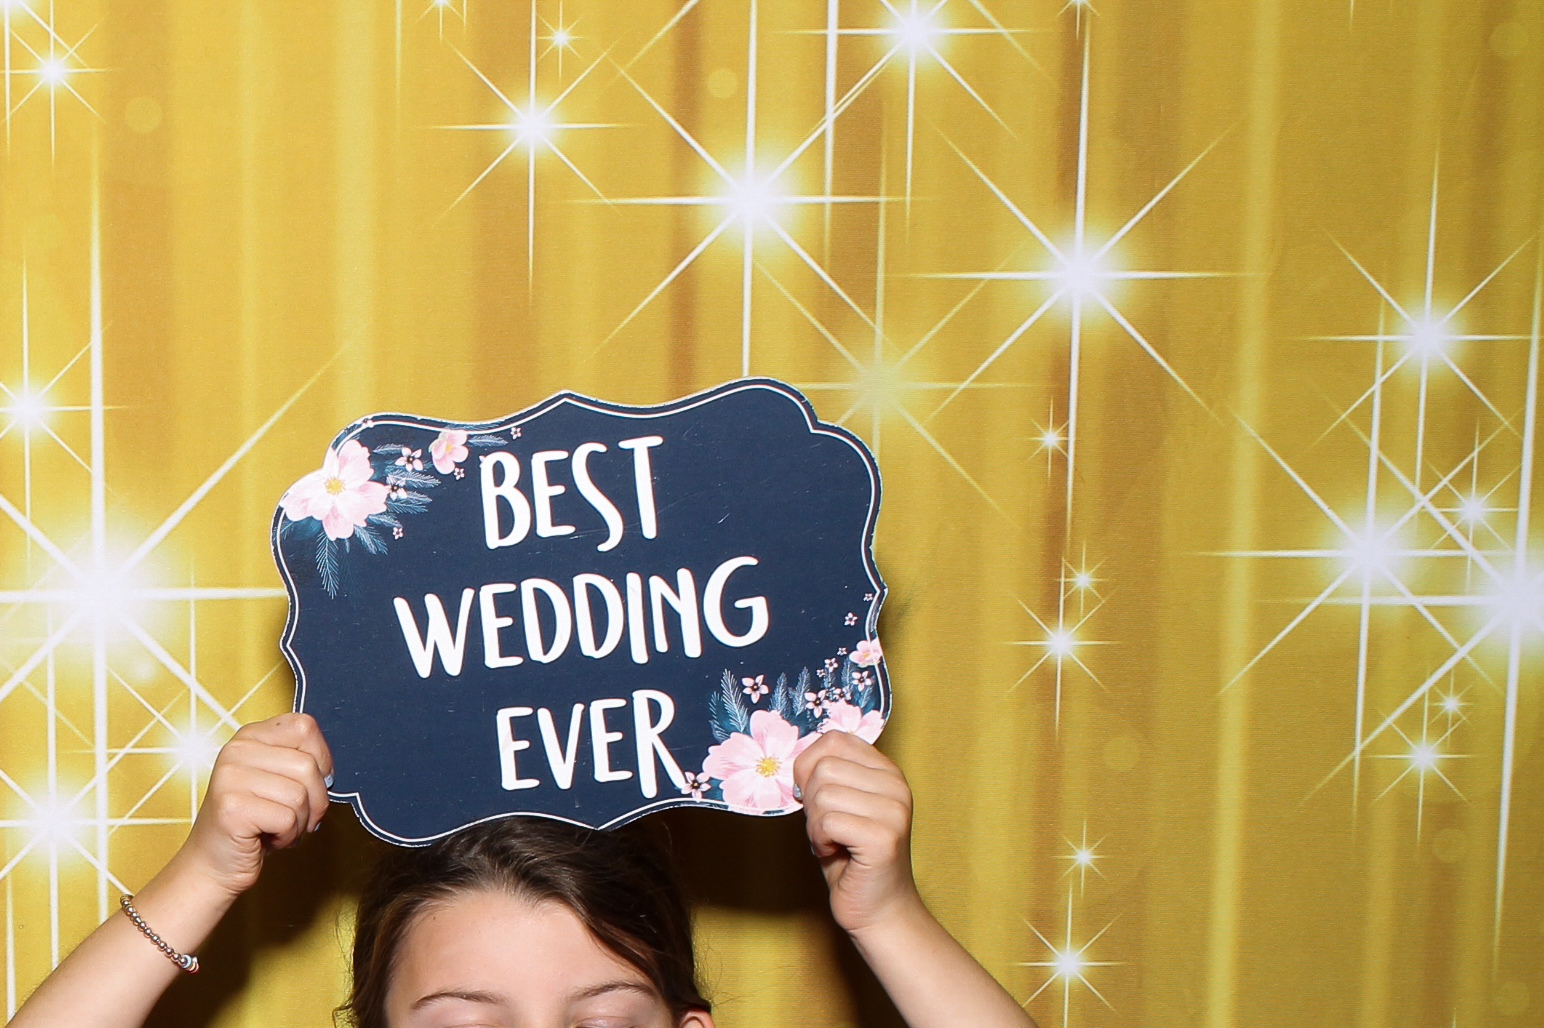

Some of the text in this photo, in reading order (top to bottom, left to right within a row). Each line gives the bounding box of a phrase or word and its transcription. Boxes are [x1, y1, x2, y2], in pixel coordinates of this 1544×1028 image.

[479, 436, 663, 552] BEST
[394, 557, 769, 678] WEDDING
[497, 690, 686, 798] EVER
